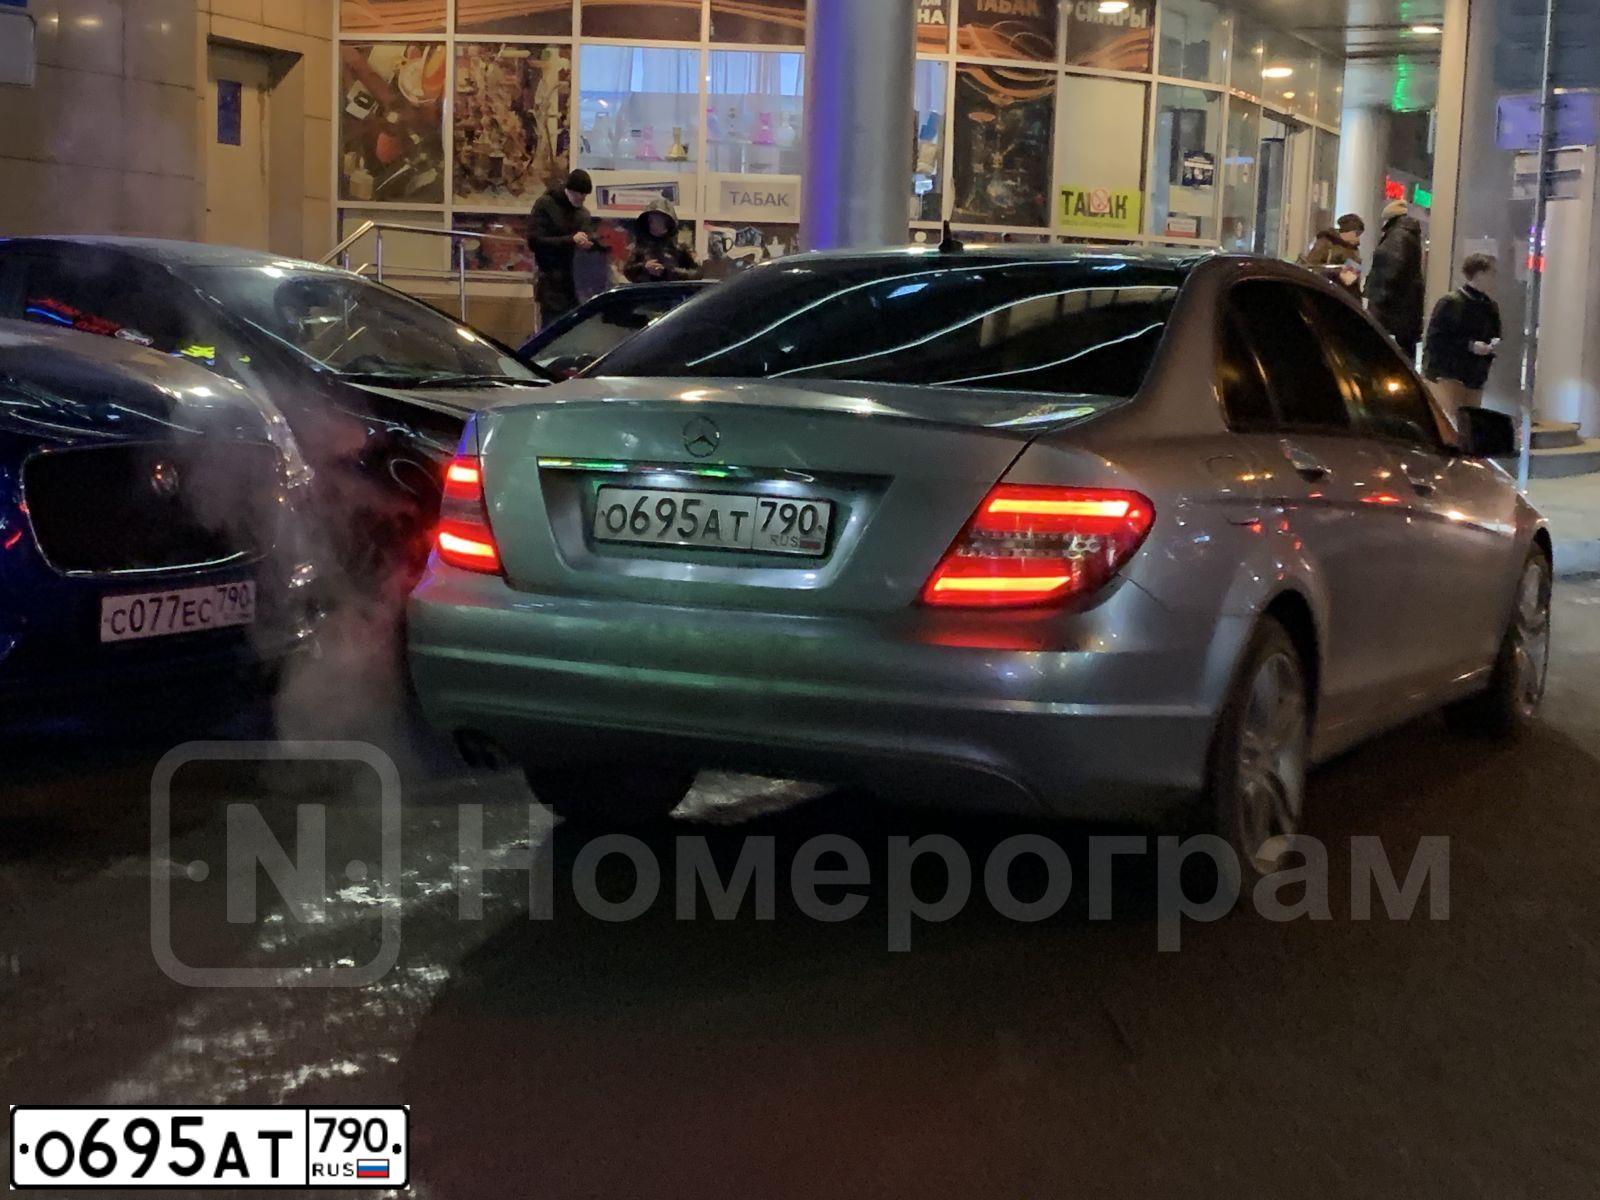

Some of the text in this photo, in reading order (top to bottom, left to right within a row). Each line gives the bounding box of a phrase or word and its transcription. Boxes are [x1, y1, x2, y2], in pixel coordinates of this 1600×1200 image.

[728, 190, 789, 207] ТАБАК
[760, 501, 819, 535] 790
[770, 534, 800, 548] RUS
